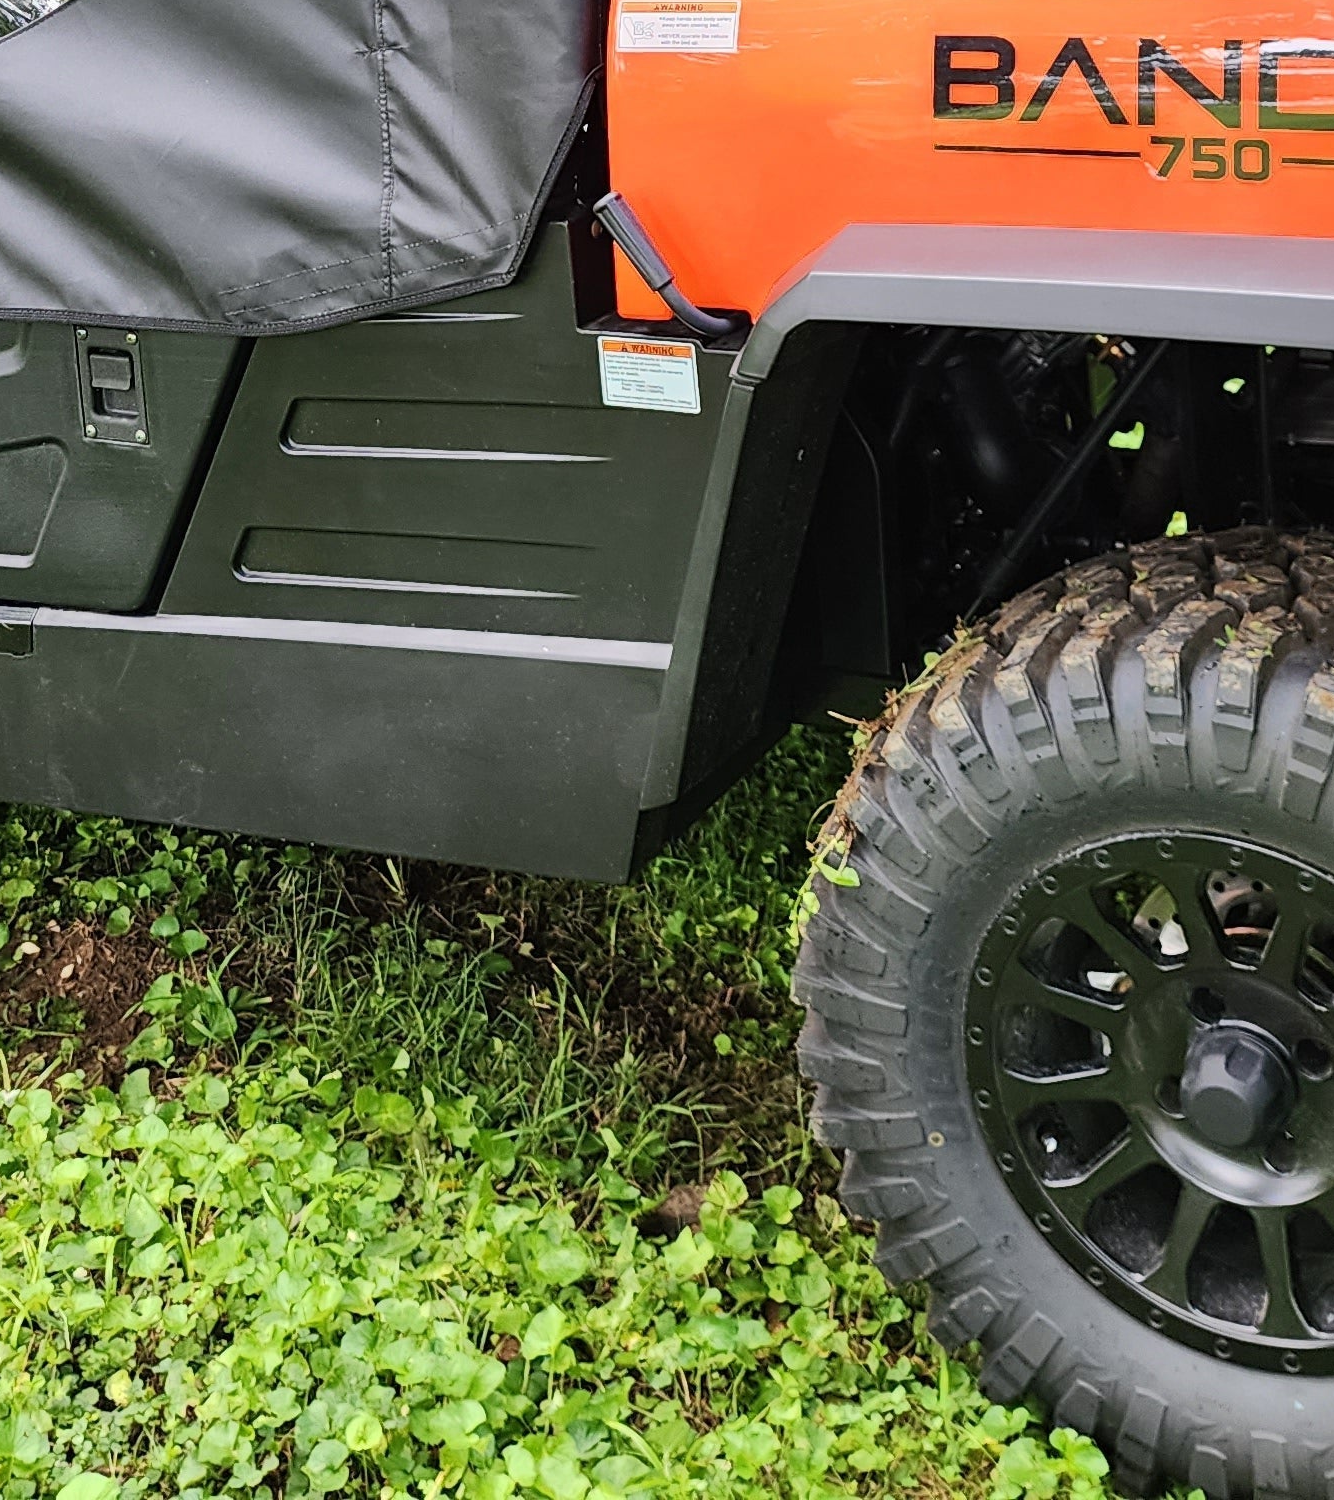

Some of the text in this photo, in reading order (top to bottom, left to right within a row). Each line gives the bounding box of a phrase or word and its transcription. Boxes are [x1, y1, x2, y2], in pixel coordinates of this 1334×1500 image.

[660, 3, 704, 12] WARNING
[1148, 135, 1272, 182] 750
[631, 344, 674, 356] WARNING
